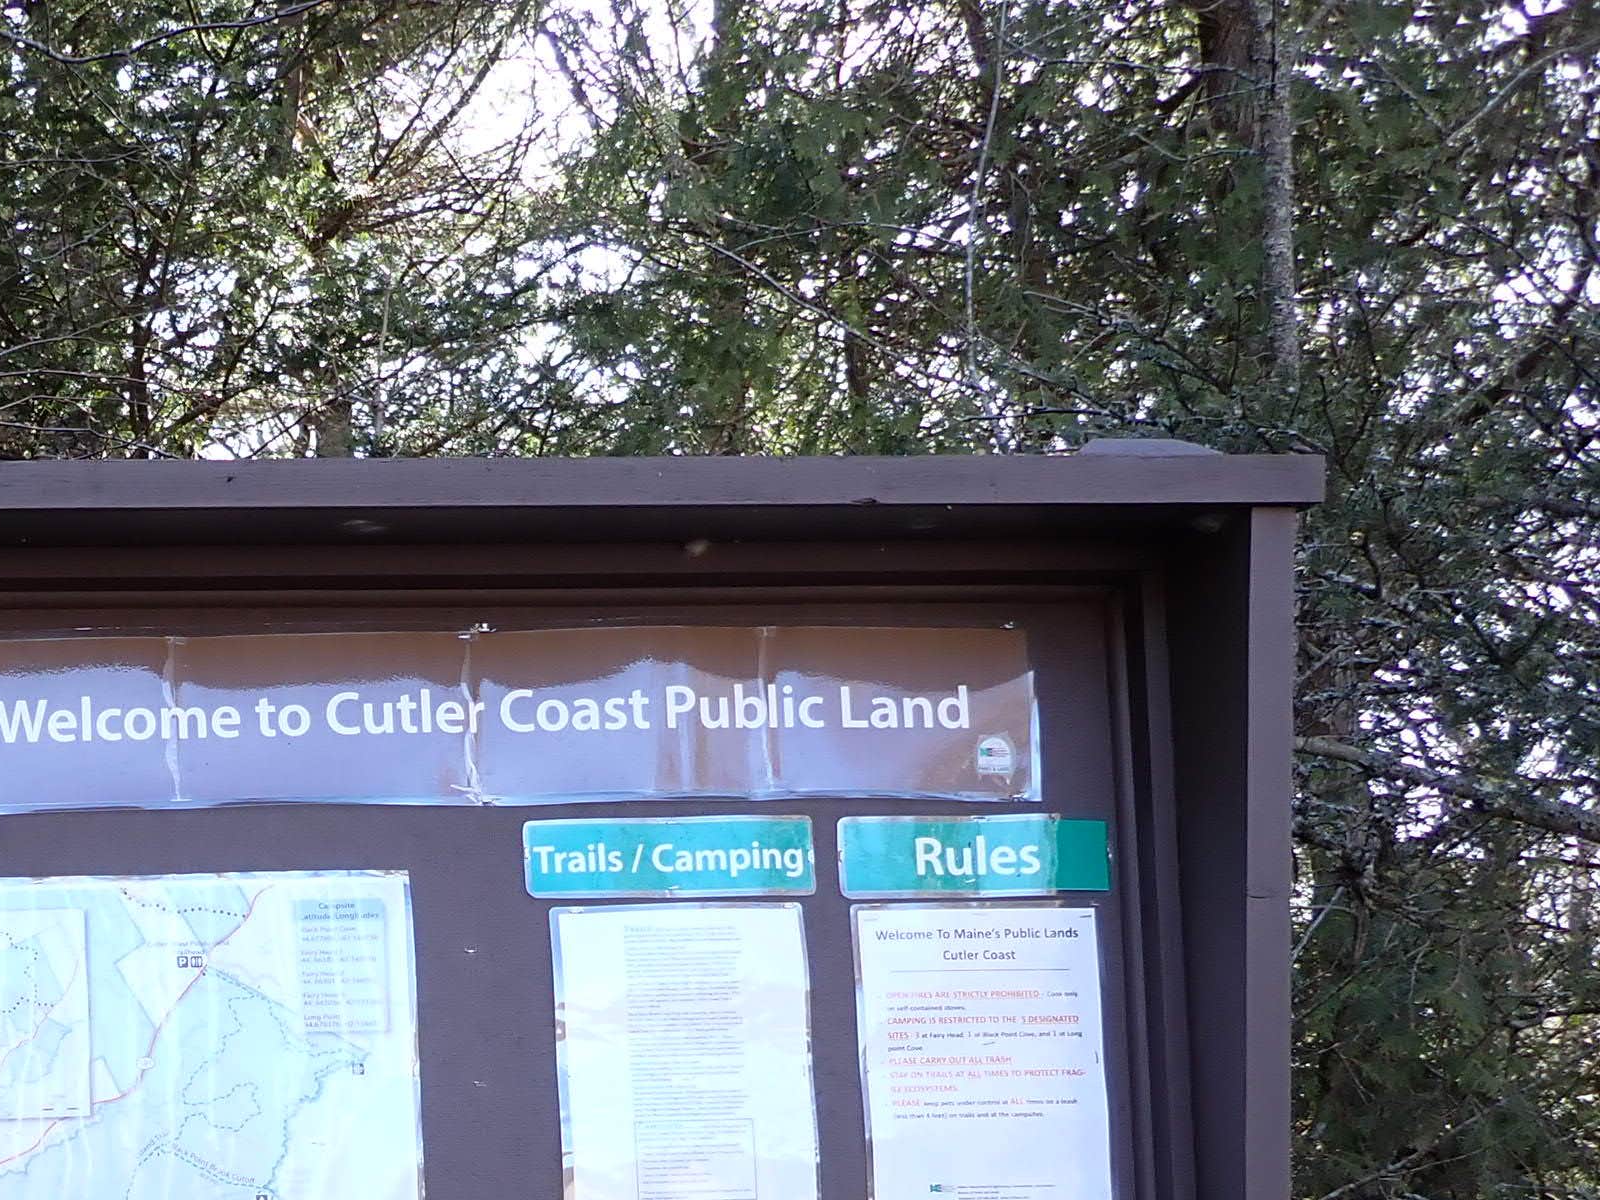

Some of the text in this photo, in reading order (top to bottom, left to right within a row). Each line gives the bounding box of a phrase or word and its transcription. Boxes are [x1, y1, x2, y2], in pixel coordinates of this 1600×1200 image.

[255, 697, 311, 738] to
[326, 688, 485, 736] Cutler
[500, 688, 651, 733] Coast
[665, 683, 825, 730] Public
[840, 685, 971, 730] Land
[532, 841, 805, 878] Trails / Camping
[914, 835, 1041, 876] Rules
[875, 928, 1079, 941] Welcome To Maine's Public Lands
[943, 950, 1016, 960] Cutler Coast
[887, 1017, 926, 1025] CAMPING
[1029, 1015, 1079, 1024] DESIGNATED
